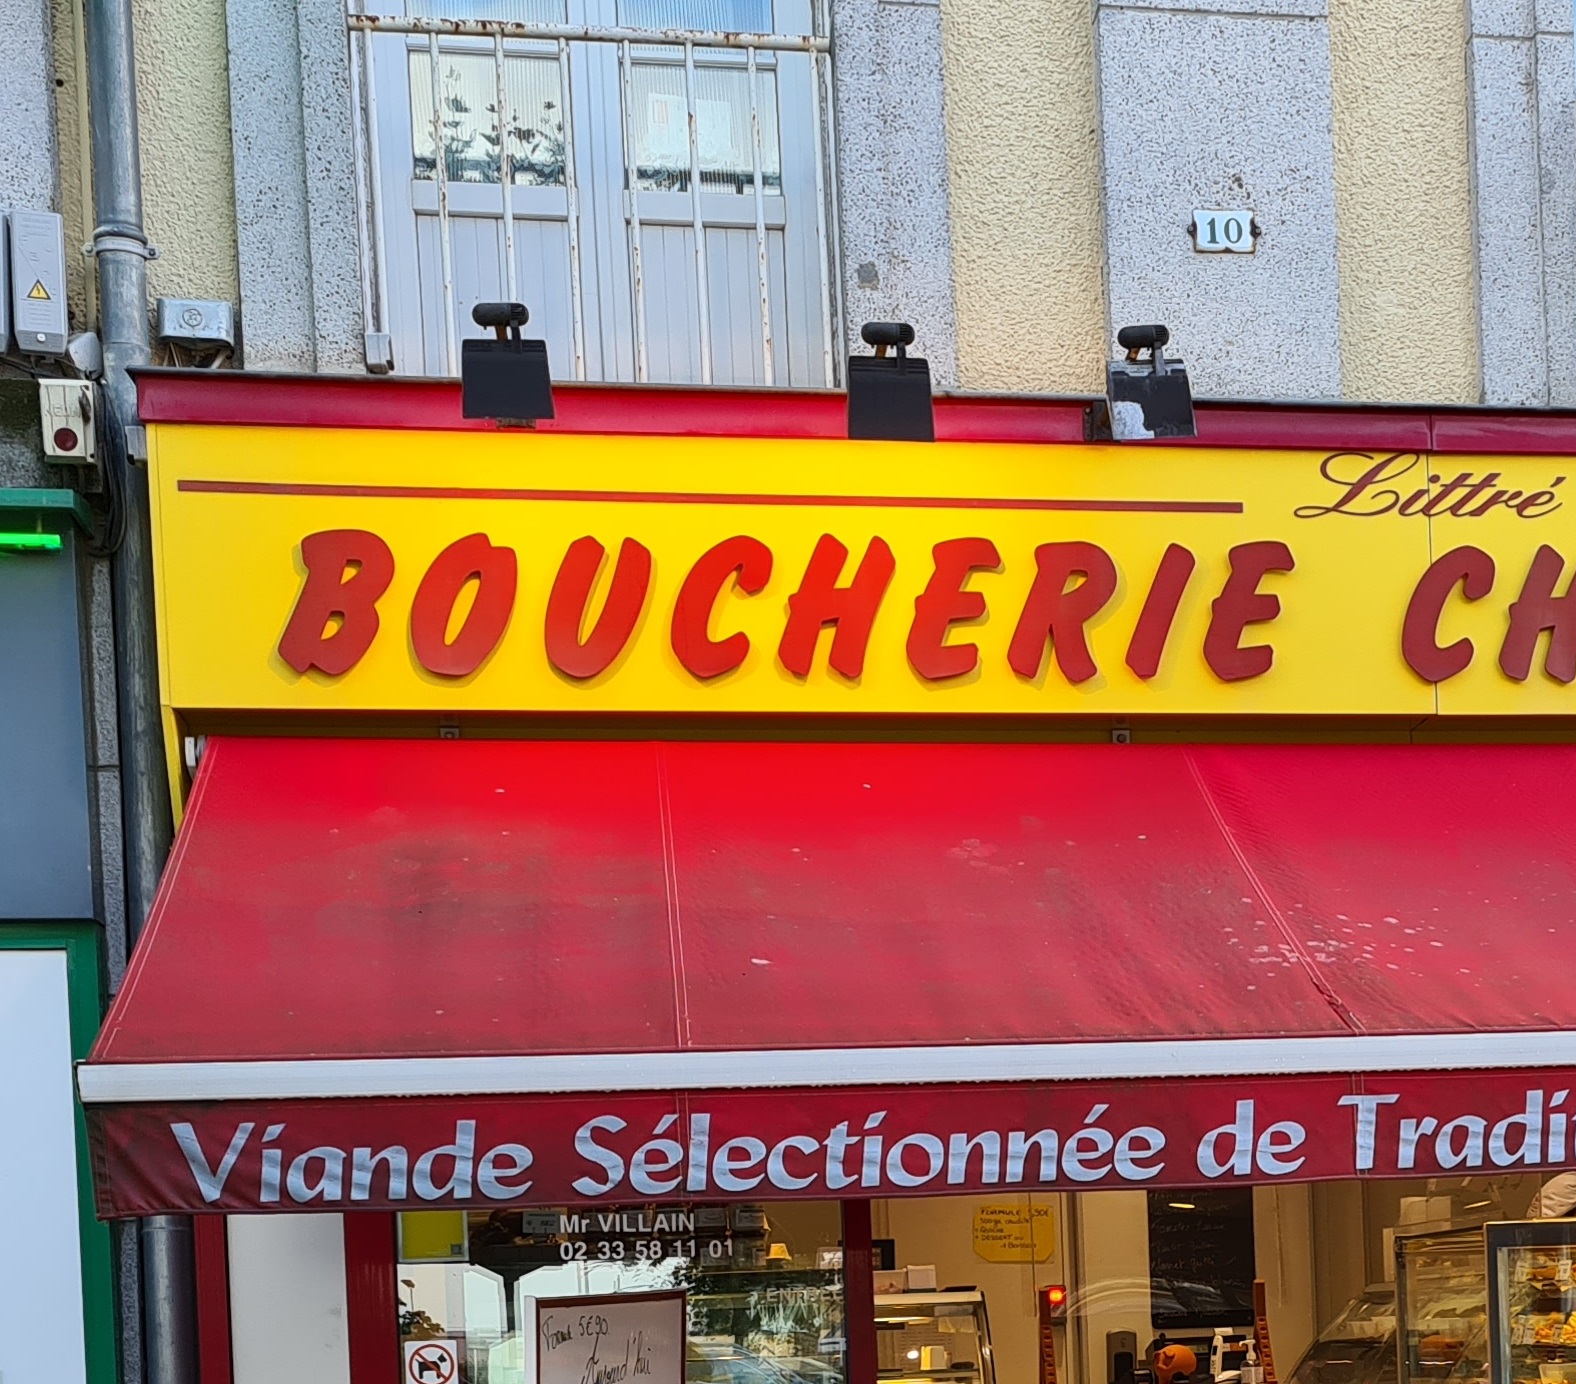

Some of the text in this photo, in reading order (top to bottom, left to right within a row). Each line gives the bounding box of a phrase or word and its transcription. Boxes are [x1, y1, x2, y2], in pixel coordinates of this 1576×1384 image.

[1206, 217, 1243, 244] 10
[1294, 452, 1567, 519] Littré
[277, 528, 1296, 683] BOUCHERIE
[169, 1119, 533, 1203] Viande
[571, 1103, 1165, 1197] Sélectionnée
[1197, 1099, 1308, 1178] de
[560, 1214, 590, 1233] Mr
[597, 1213, 695, 1232] VILLAIN
[560, 1238, 734, 1260] 02 33 58 11 01
